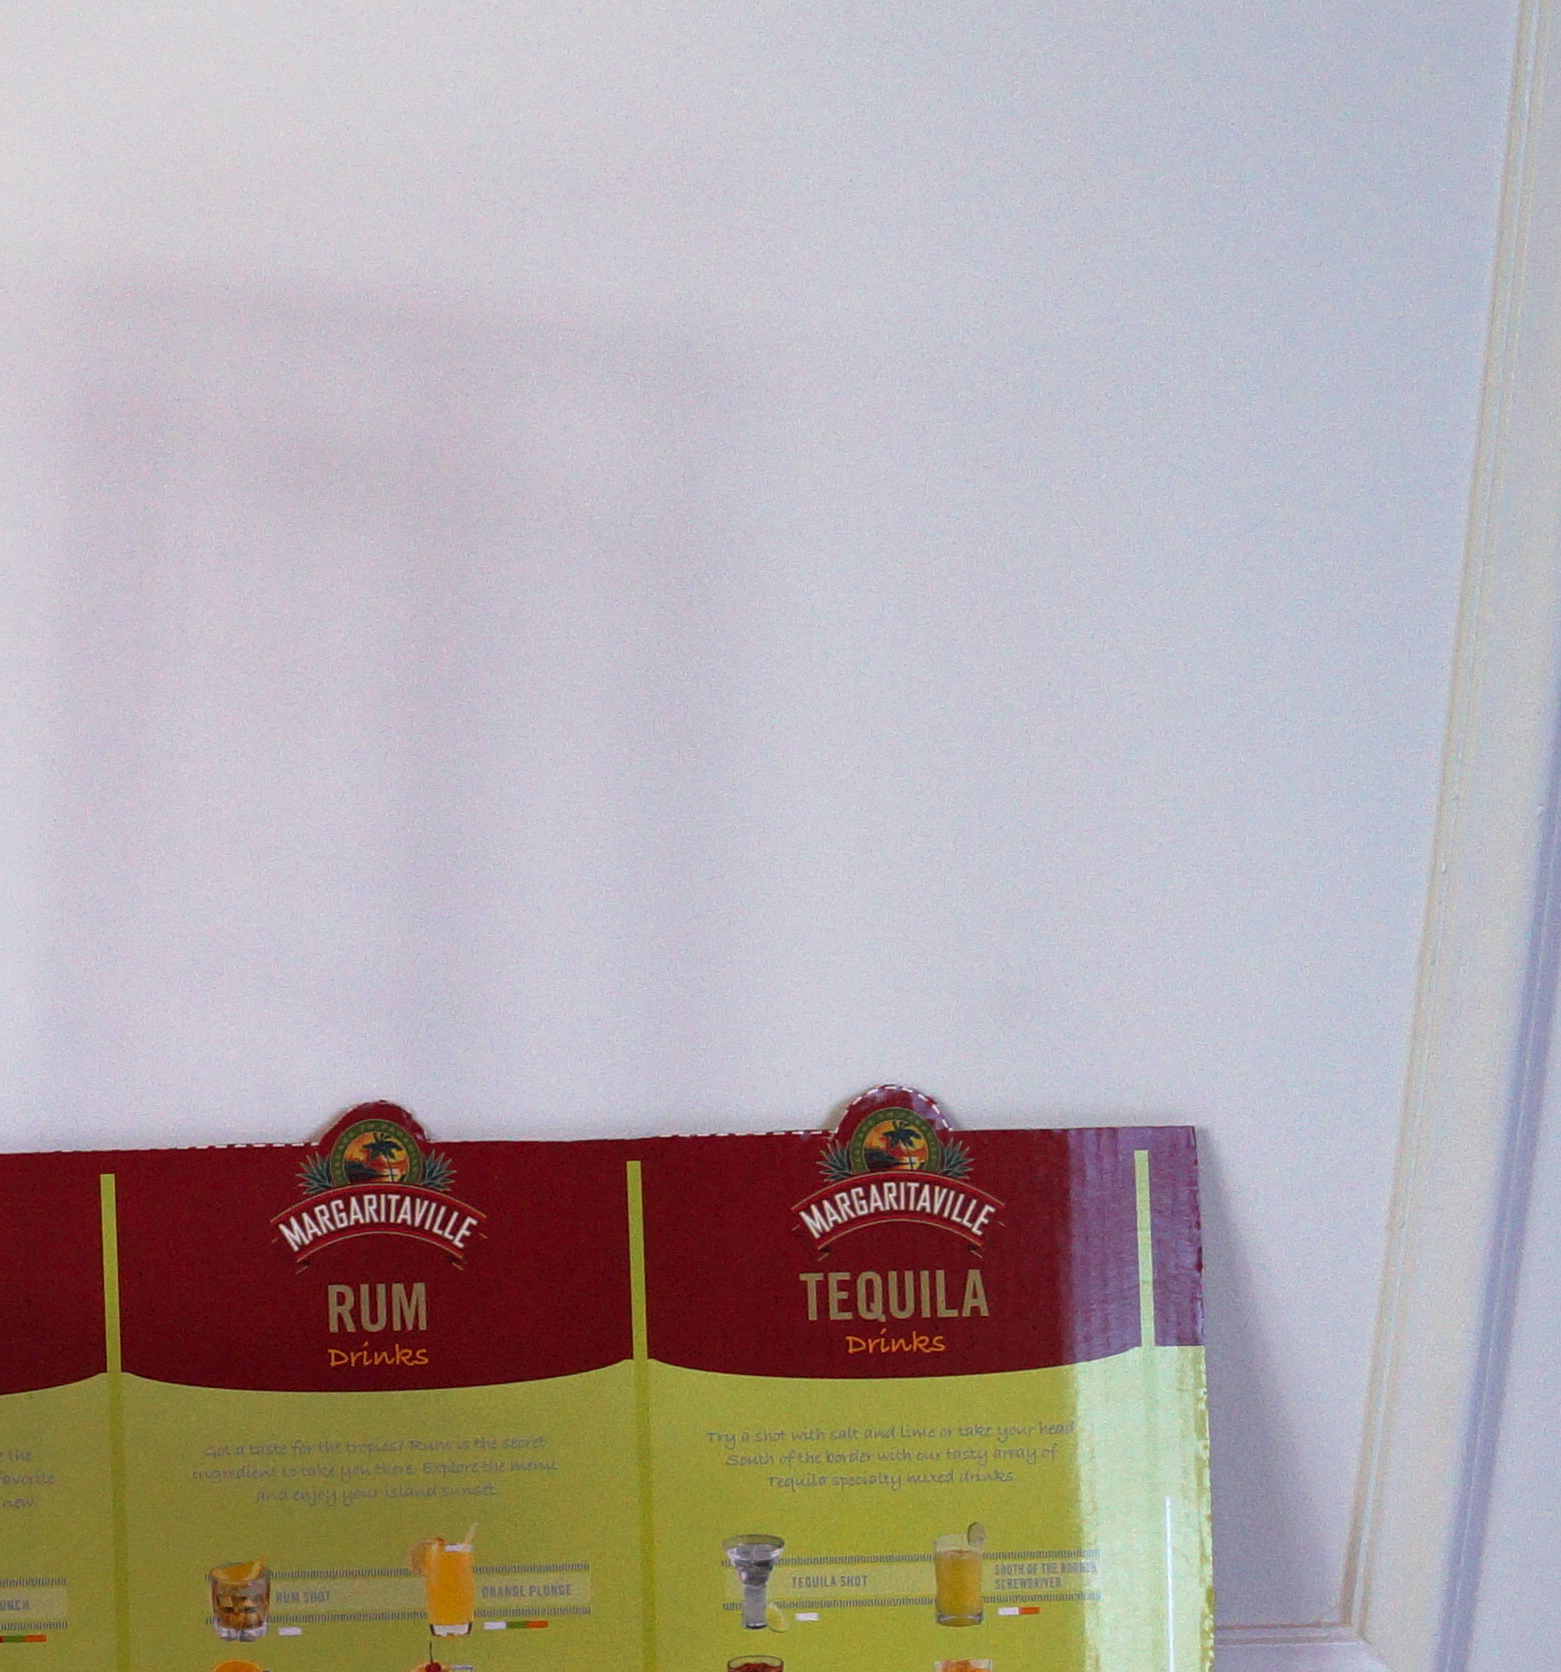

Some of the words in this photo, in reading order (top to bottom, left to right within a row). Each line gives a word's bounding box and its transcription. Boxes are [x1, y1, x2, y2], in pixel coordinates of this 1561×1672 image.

[278, 1193, 478, 1252] MARGARITAVILLE
[799, 1181, 996, 1239] MARGARITAVILLE
[328, 1283, 427, 1333] RUM
[799, 1269, 989, 1322] TEQUILA
[328, 1340, 429, 1368] Drinks
[845, 1328, 946, 1355] Drinks
[482, 1585, 526, 1597] ORANGE
[792, 1576, 836, 1589] TEQUILA
[840, 1575, 869, 1587] SHOT
